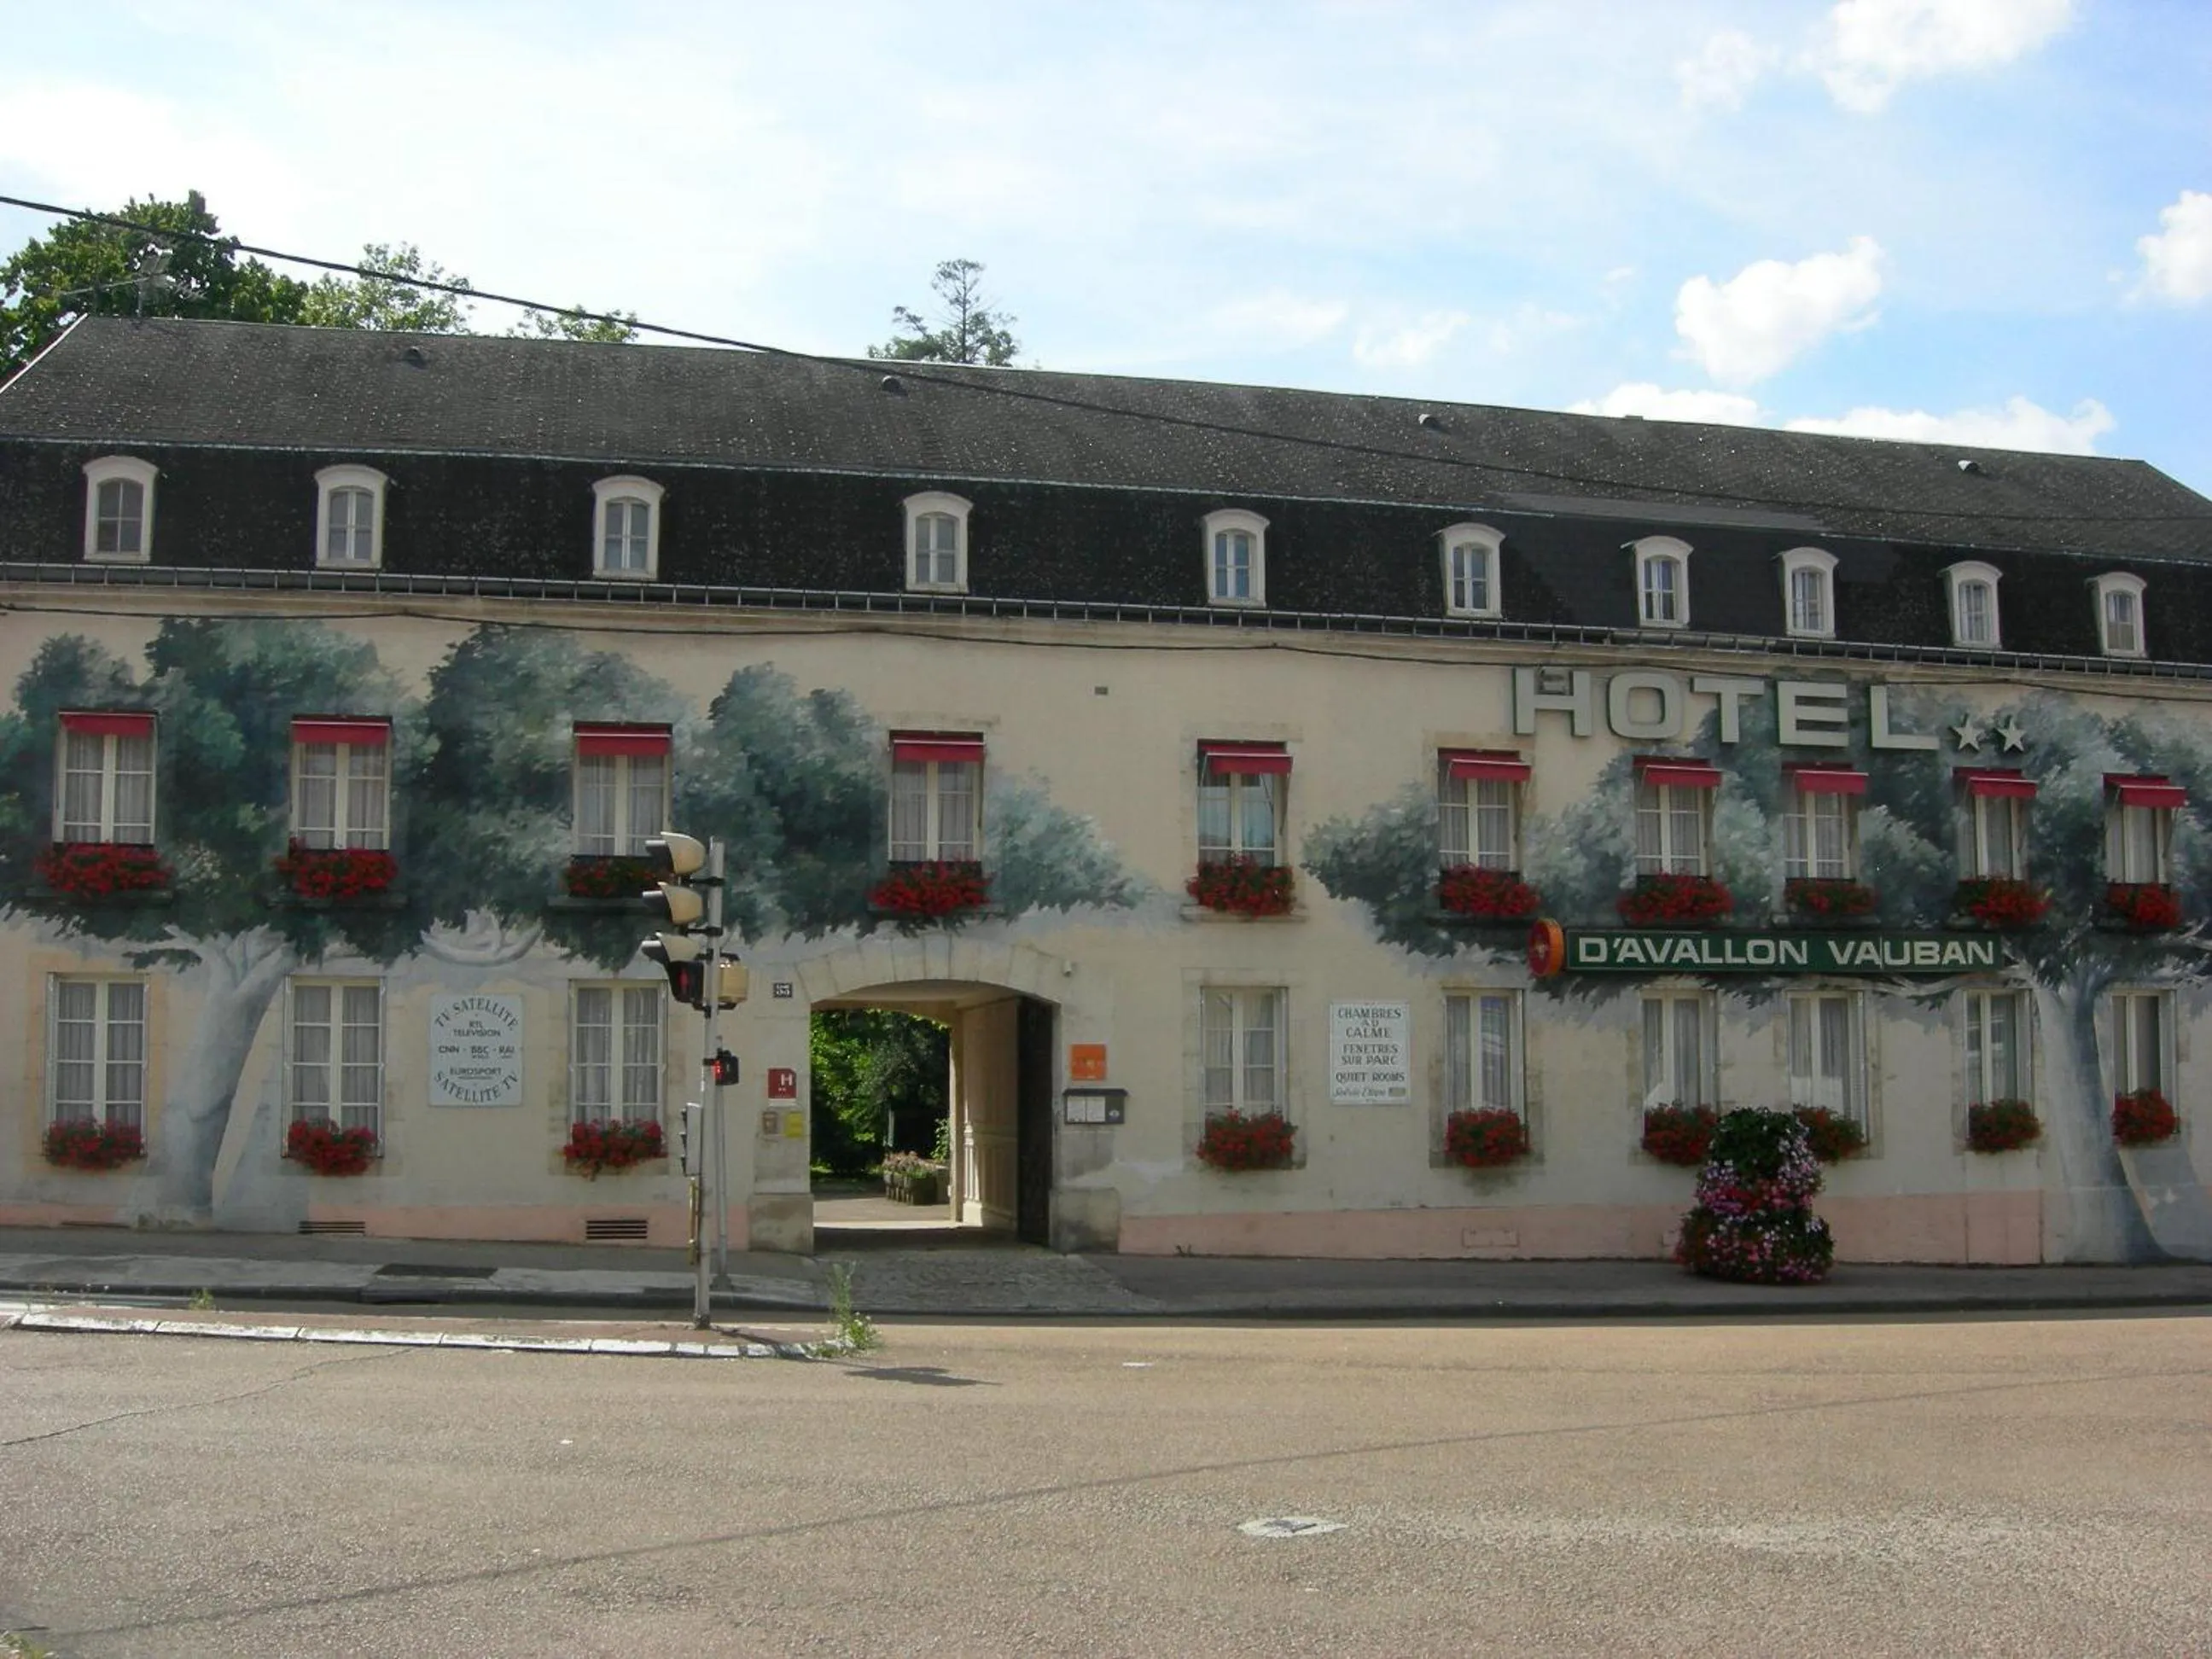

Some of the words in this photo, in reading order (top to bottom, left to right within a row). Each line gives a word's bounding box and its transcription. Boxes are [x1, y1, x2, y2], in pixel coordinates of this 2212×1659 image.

[1512, 666, 1940, 750] HOTEL
[1579, 937, 1807, 965] D'AVALLON
[1828, 939, 1995, 966] VAUBAN
[434, 1009, 451, 1027] TV
[452, 997, 519, 1028] SATELLITE
[1337, 1007, 1402, 1019] CHAMBRES
[1361, 1019, 1379, 1027] AU
[1345, 1027, 1393, 1039] CALME
[470, 1045, 489, 1054] BBC
[1341, 1055, 1362, 1066] SUR
[1366, 1055, 1397, 1066] PARC
[781, 1073, 793, 1086] H
[1336, 1072, 1367, 1084] QUIET
[1371, 1072, 1406, 1083] ROOMS
[434, 1071, 502, 1103] SATELLITE
[502, 1072, 518, 1090] TV
